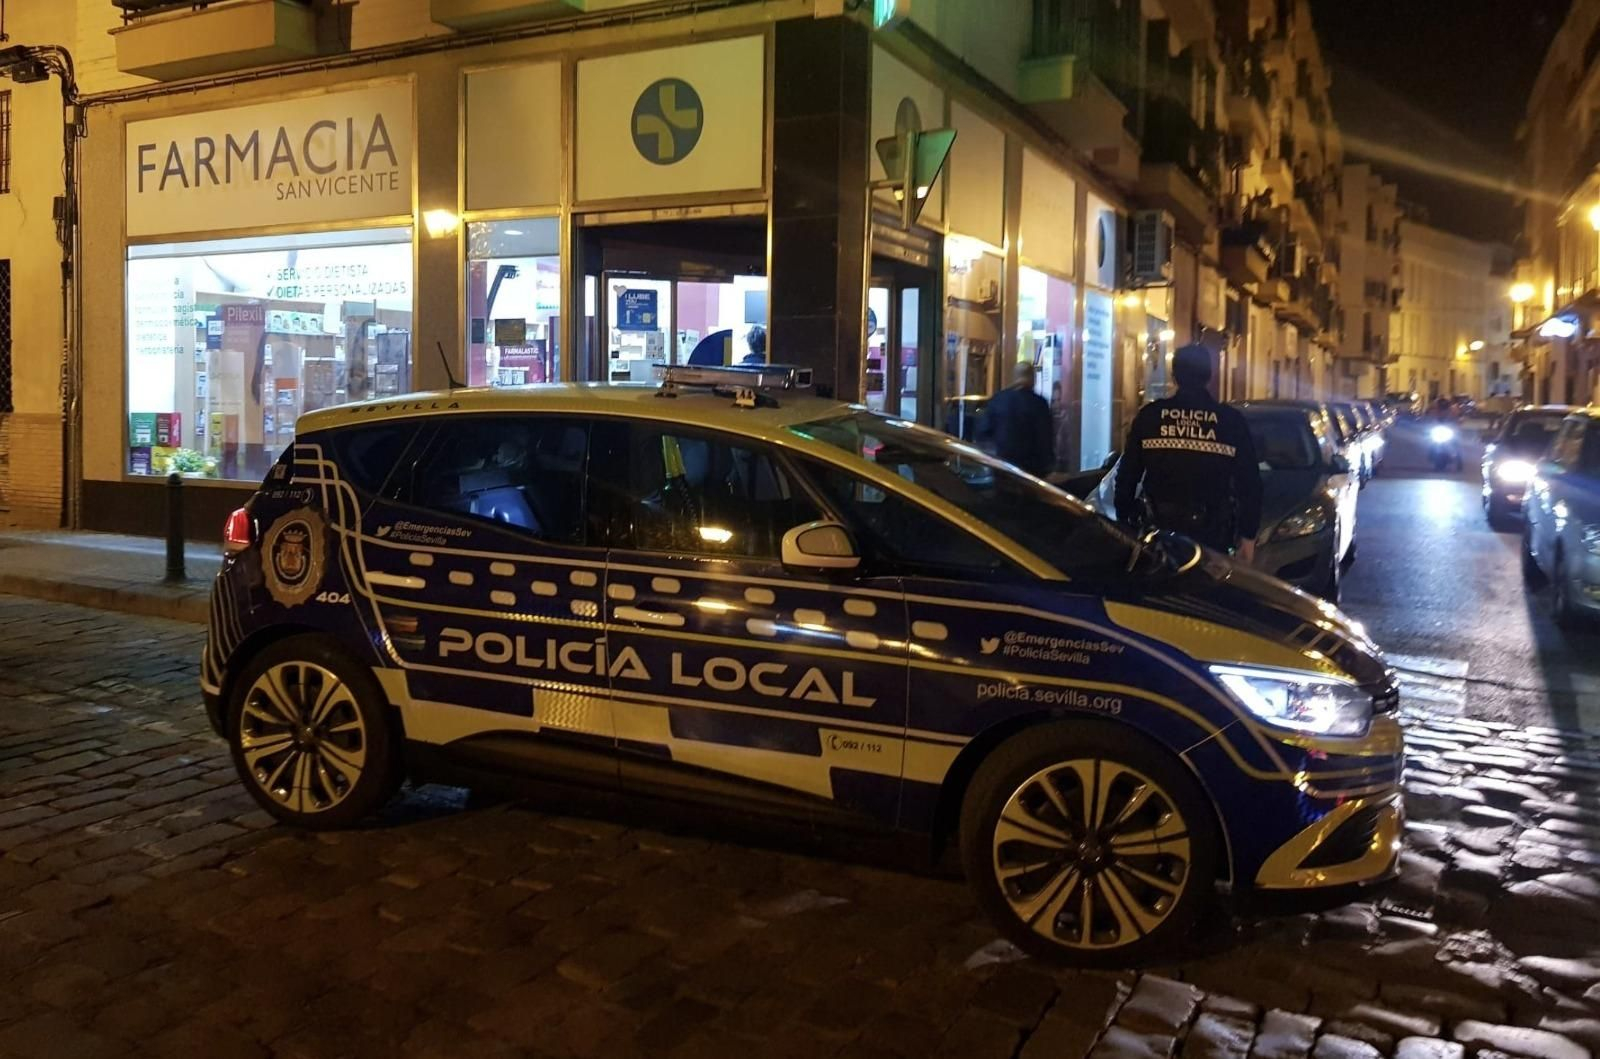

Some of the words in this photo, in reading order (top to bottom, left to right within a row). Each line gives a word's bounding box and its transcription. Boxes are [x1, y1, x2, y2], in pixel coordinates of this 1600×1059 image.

[138, 113, 398, 193] FARMACIA
[276, 179, 311, 200] SAN
[311, 171, 400, 197] VICENTE
[277, 266, 320, 281] SERVCO
[227, 306, 263, 321] Pilexil
[351, 402, 460, 413] SEVILLA
[1161, 408, 1218, 423] POLICIA
[1160, 425, 1217, 440] SEVILLA
[315, 592, 350, 604] 404
[1003, 630, 1125, 654] @EmergenciasSev
[438, 627, 651, 680] POLICÍA
[672, 652, 877, 708] LOCAL
[867, 743, 882, 752] 112
